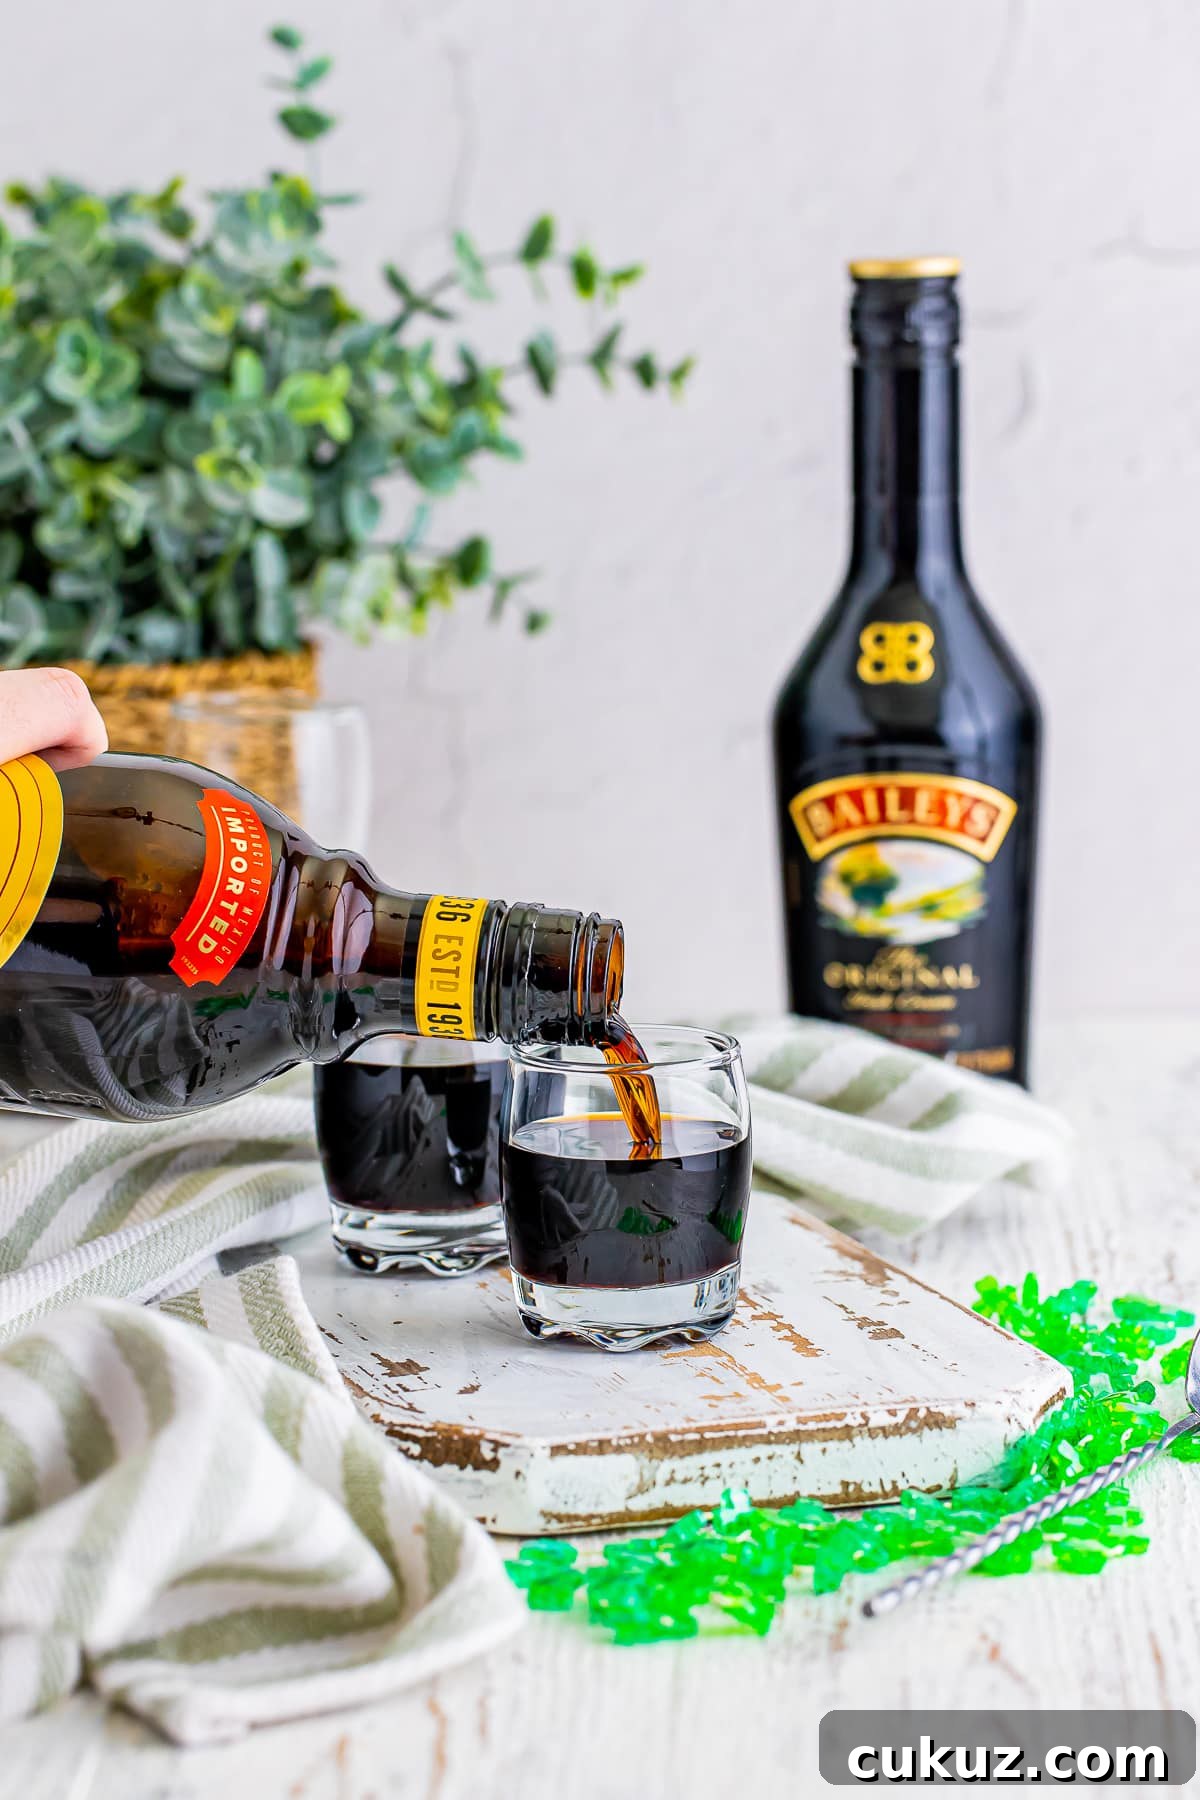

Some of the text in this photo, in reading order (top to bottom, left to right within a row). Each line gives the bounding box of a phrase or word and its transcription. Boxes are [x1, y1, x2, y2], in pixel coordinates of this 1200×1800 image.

[805, 786, 998, 838] BAILEYS
[197, 806, 248, 954] IMPORTED
[214, 809, 264, 965] PRODUCT OF MEXICO
[435, 895, 479, 923] 36
[426, 1002, 467, 1040] 193
